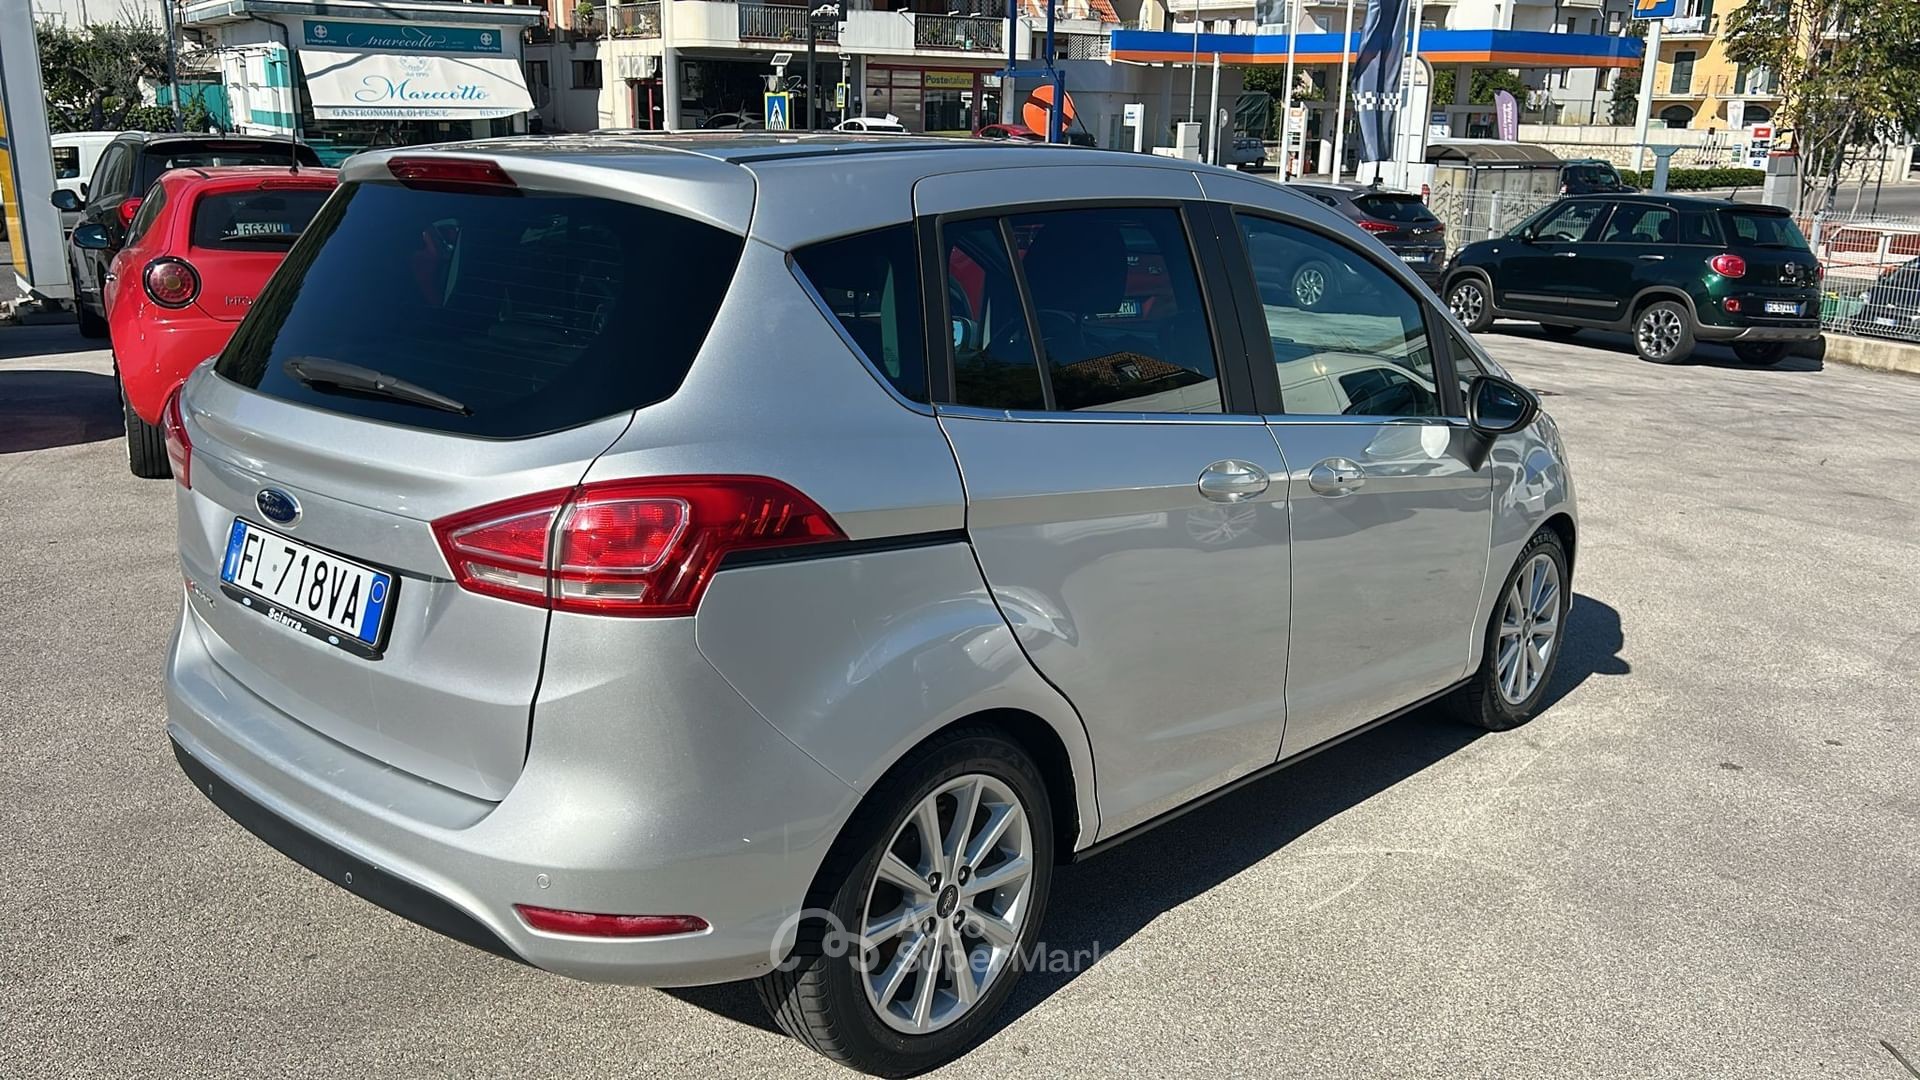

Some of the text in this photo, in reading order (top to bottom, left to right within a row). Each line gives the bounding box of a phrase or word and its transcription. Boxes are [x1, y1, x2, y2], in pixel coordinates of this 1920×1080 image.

[333, 109, 406, 118] GASTRONOMIA
[238, 533, 264, 590] FL
[274, 546, 362, 629] 718VA
